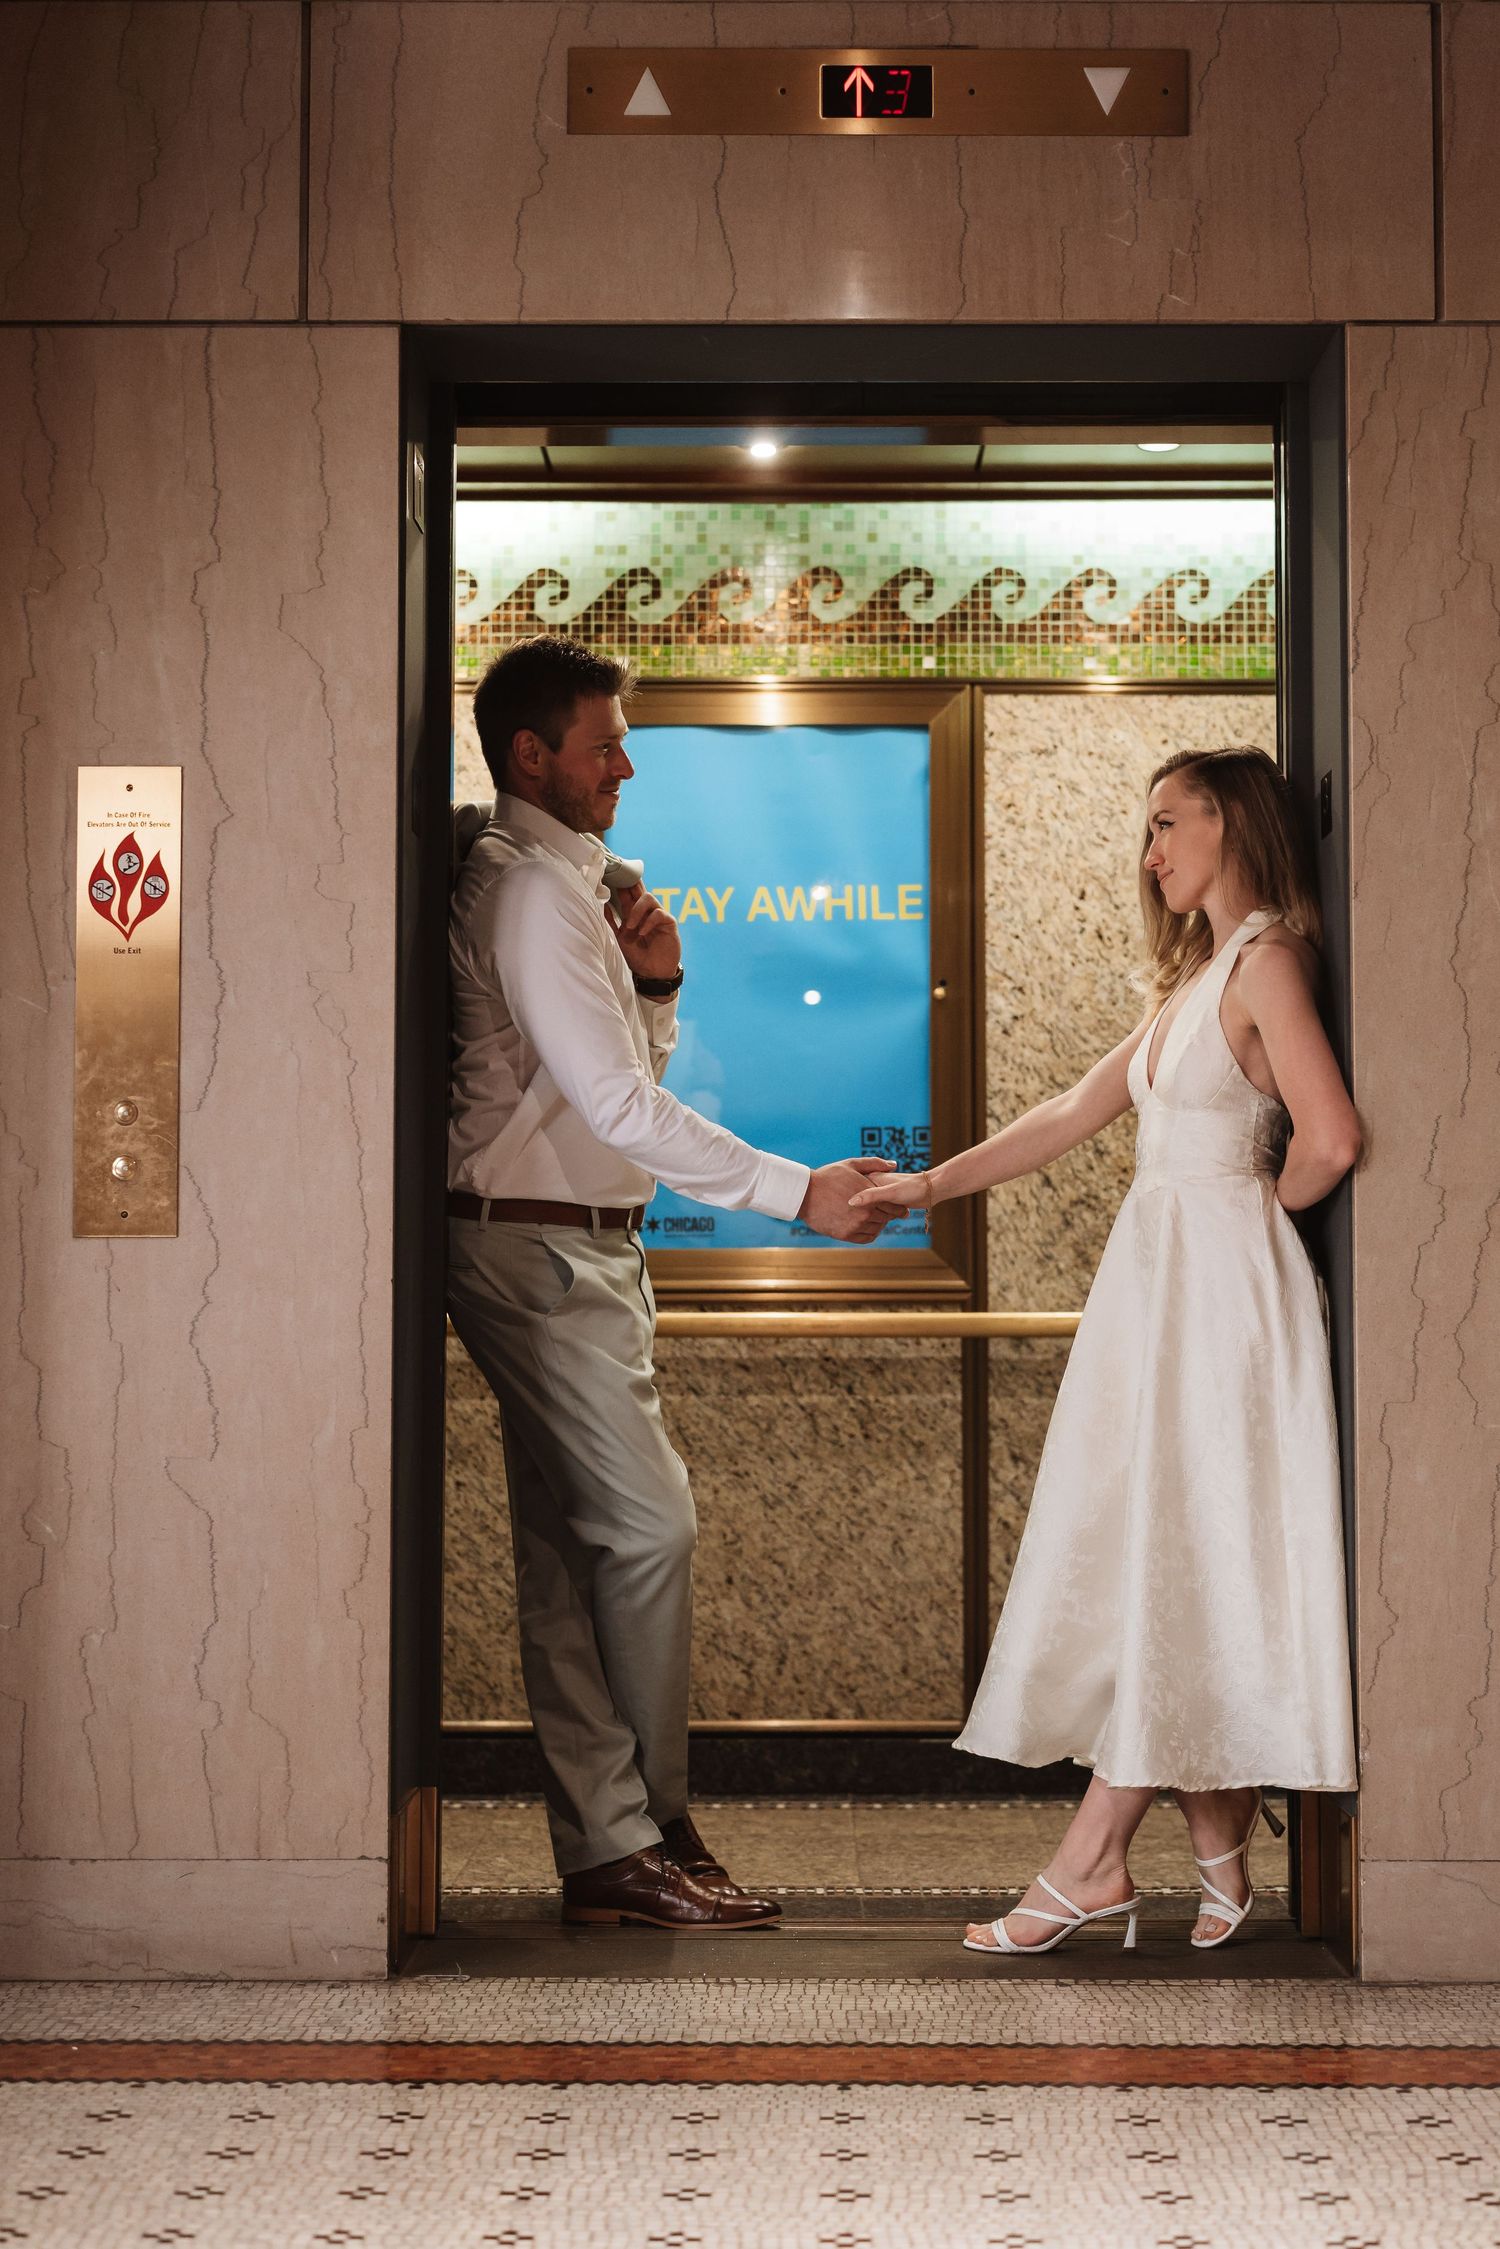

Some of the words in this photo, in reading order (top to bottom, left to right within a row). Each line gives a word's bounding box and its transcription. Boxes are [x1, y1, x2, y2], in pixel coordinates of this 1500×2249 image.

[881, 69, 912, 114] 3
[652, 886, 735, 924] TAY
[746, 884, 924, 922] AWHILE
[664, 1216, 715, 1232] CHICAGO
